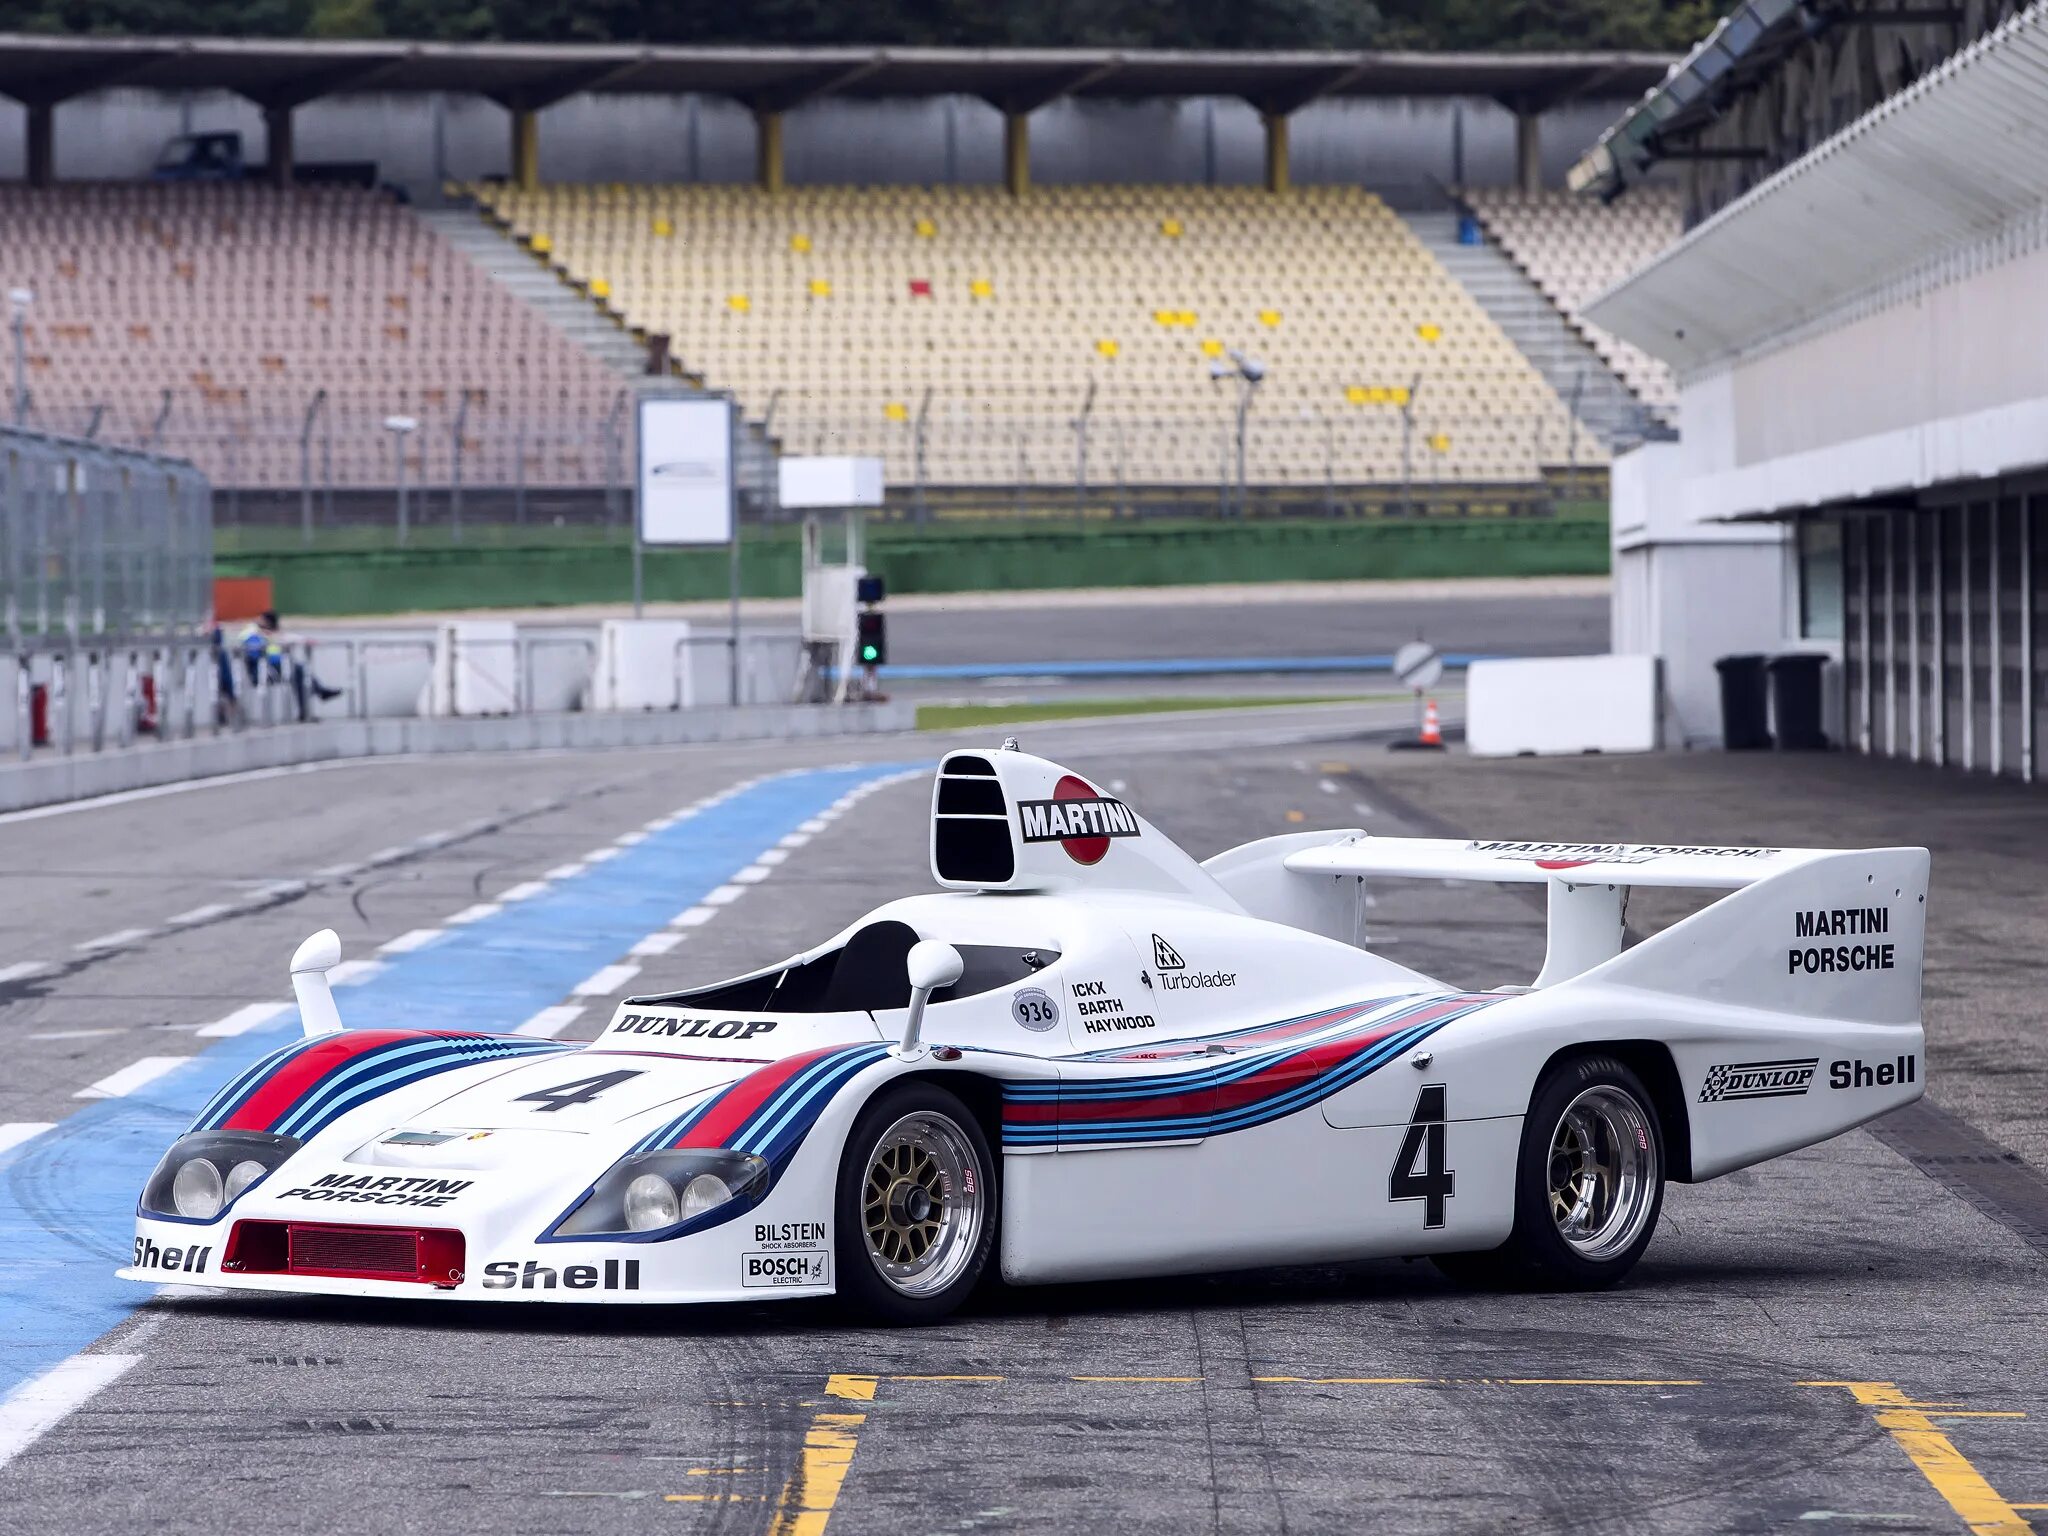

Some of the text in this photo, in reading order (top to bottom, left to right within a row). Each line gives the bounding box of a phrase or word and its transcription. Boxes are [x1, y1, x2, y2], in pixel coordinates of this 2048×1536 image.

[1021, 802, 1136, 838] MARTINI
[1795, 907, 1889, 938] MARTINI
[1788, 944, 1895, 975] PORSCHE
[1071, 981, 1107, 998] ICKX
[1157, 970, 1237, 990] Turbolader
[1018, 1000, 1053, 1023] 936
[1078, 998, 1124, 1016] BARTH
[613, 1014, 778, 1040] DUNLOP
[1084, 1015, 1156, 1034] HAYWOOD
[1726, 1069, 1813, 1090] DUNLOP
[1829, 1055, 1915, 1090] Shell
[508, 1068, 650, 1112] 4
[1636, 1128, 1648, 1150] BBS
[1389, 1083, 1455, 1230] 4
[310, 1173, 475, 1194] MARTINI
[964, 1169, 975, 1193] BBS
[275, 1188, 459, 1208] PORSCHE
[755, 1222, 825, 1242] BILSTEIN
[133, 1236, 213, 1273] Shell
[784, 1241, 817, 1249] ABSORBERS
[482, 1259, 640, 1290] Shell
[749, 1257, 808, 1276] BOSCH
[773, 1276, 803, 1285] ELECTRIC
